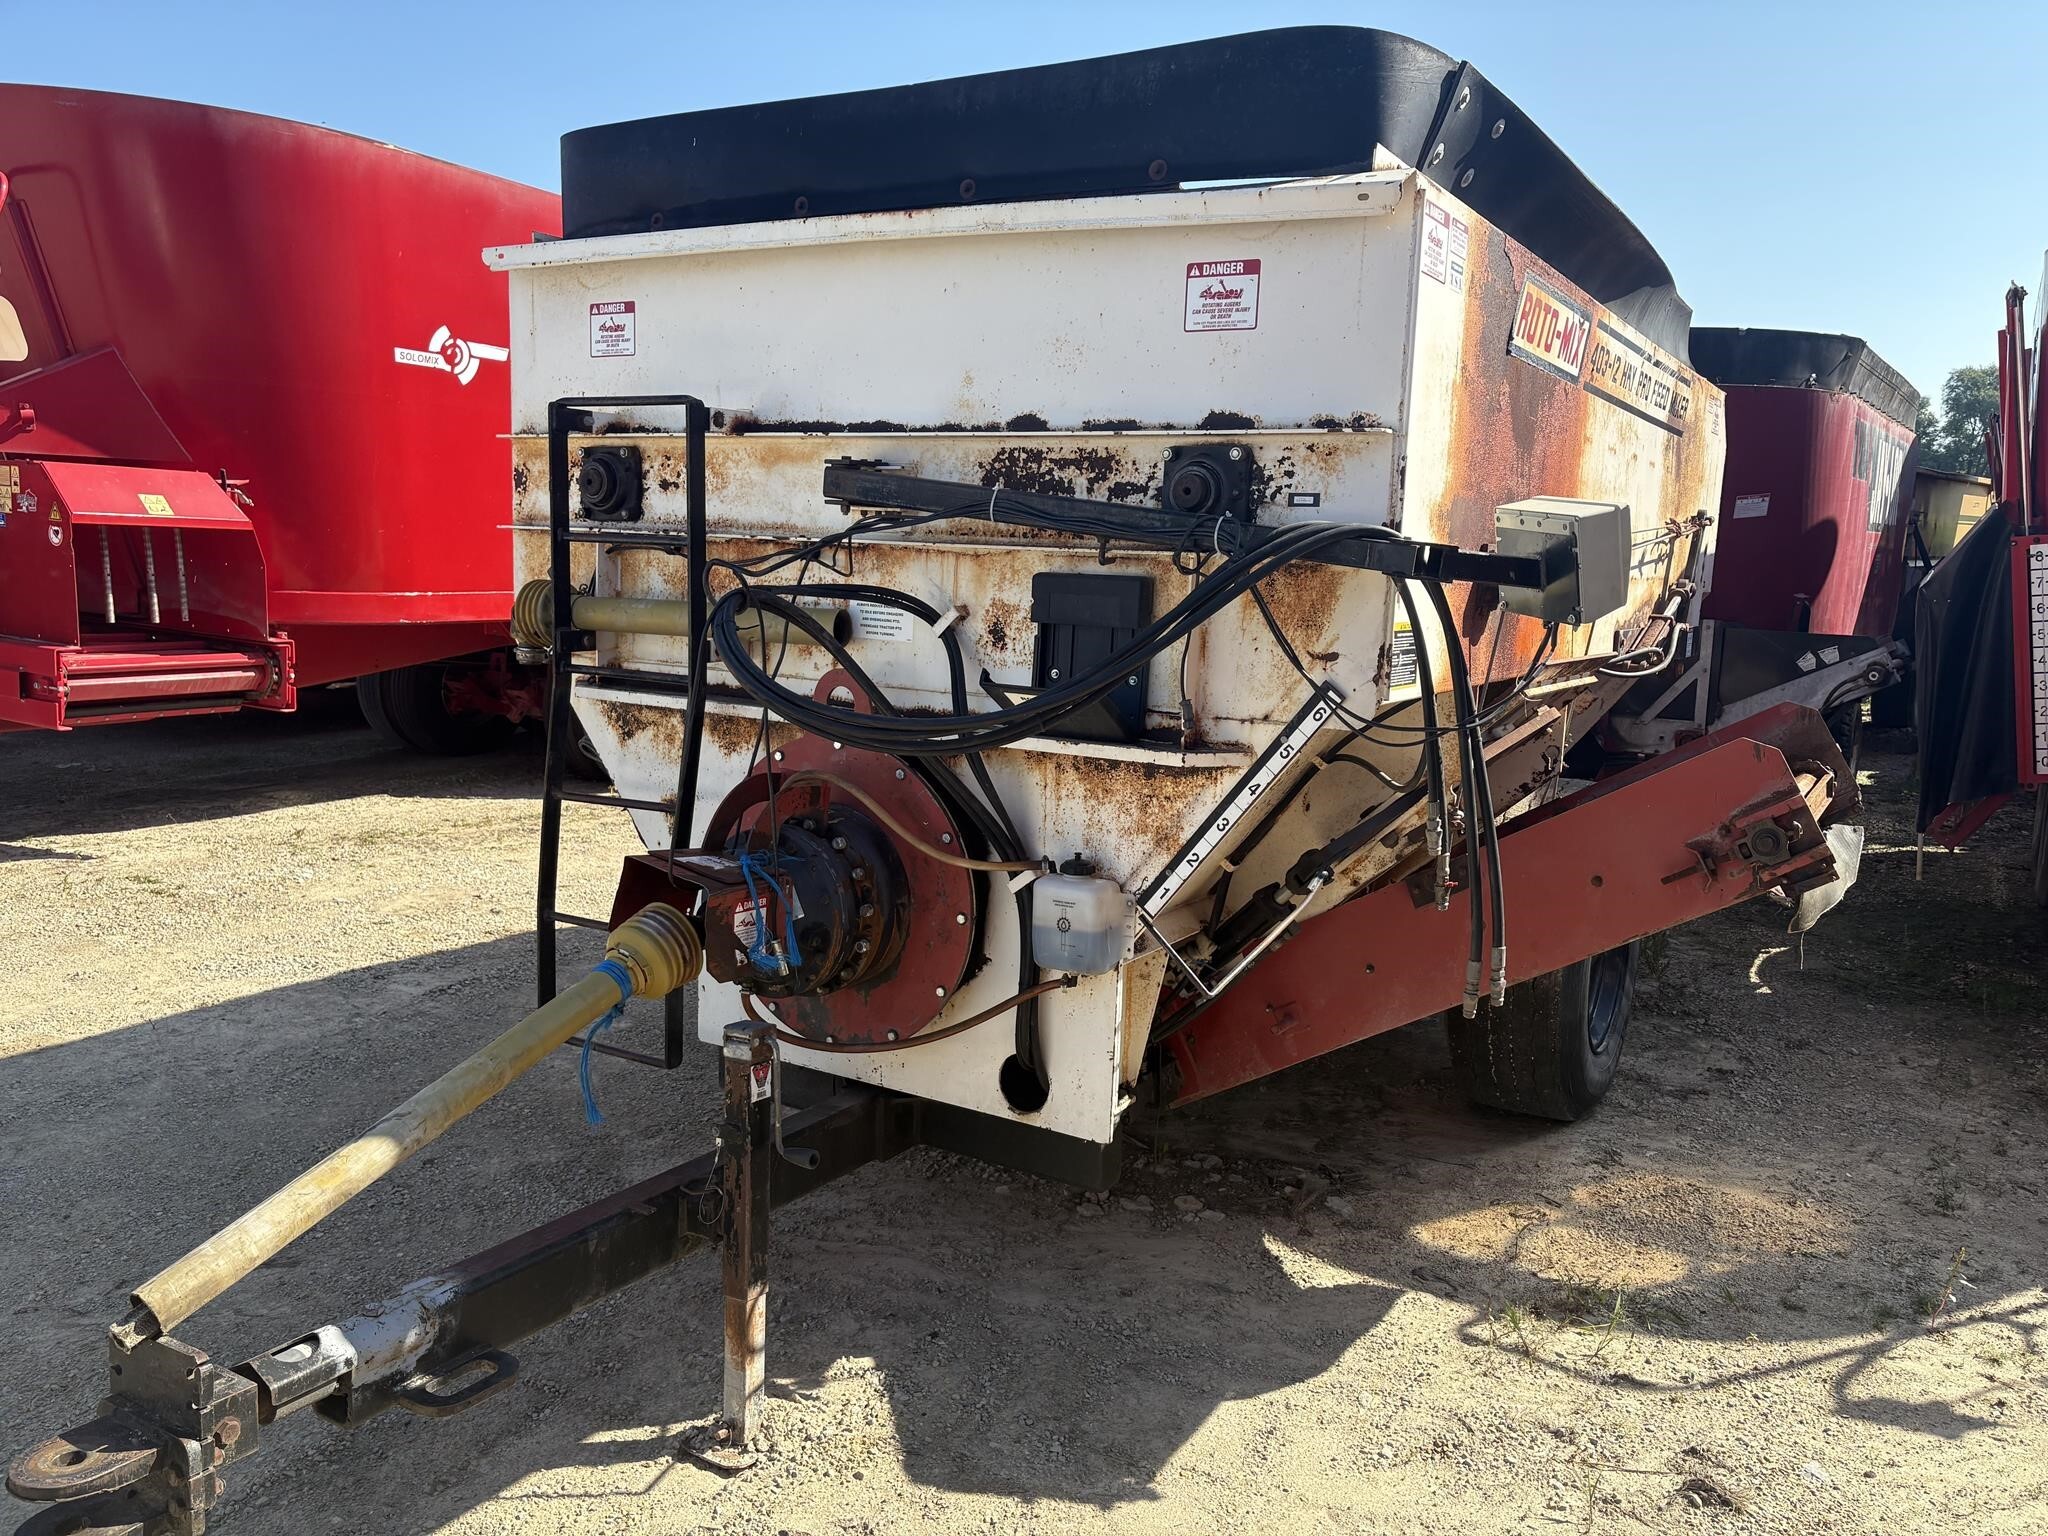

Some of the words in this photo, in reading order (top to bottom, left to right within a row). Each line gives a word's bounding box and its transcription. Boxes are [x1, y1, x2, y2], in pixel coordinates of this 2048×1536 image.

[1202, 262, 1244, 275] DANGER
[599, 303, 625, 313] DANGER
[1515, 291, 1587, 370] ROTO-MIX
[1590, 342, 1622, 384] 403-12
[1620, 360, 1637, 392] HAY
[1636, 370, 1652, 402] PRO
[1650, 379, 1671, 411] FEED
[2035, 550, 2044, 562] 8
[2035, 576, 2044, 588] 7
[2036, 602, 2046, 614] 6
[2037, 628, 2046, 640] 5
[2038, 654, 2047, 664] 4
[2039, 680, 2048, 692] 3
[1312, 706, 1327, 722] 6
[2040, 705, 2048, 717] 2
[2041, 731, 2047, 742] 1
[1279, 744, 1295, 760] 5
[1247, 783, 1262, 796] 4
[1216, 817, 1230, 832] 3
[1185, 852, 1200, 868] 2
[1159, 886, 1171, 900] 1
